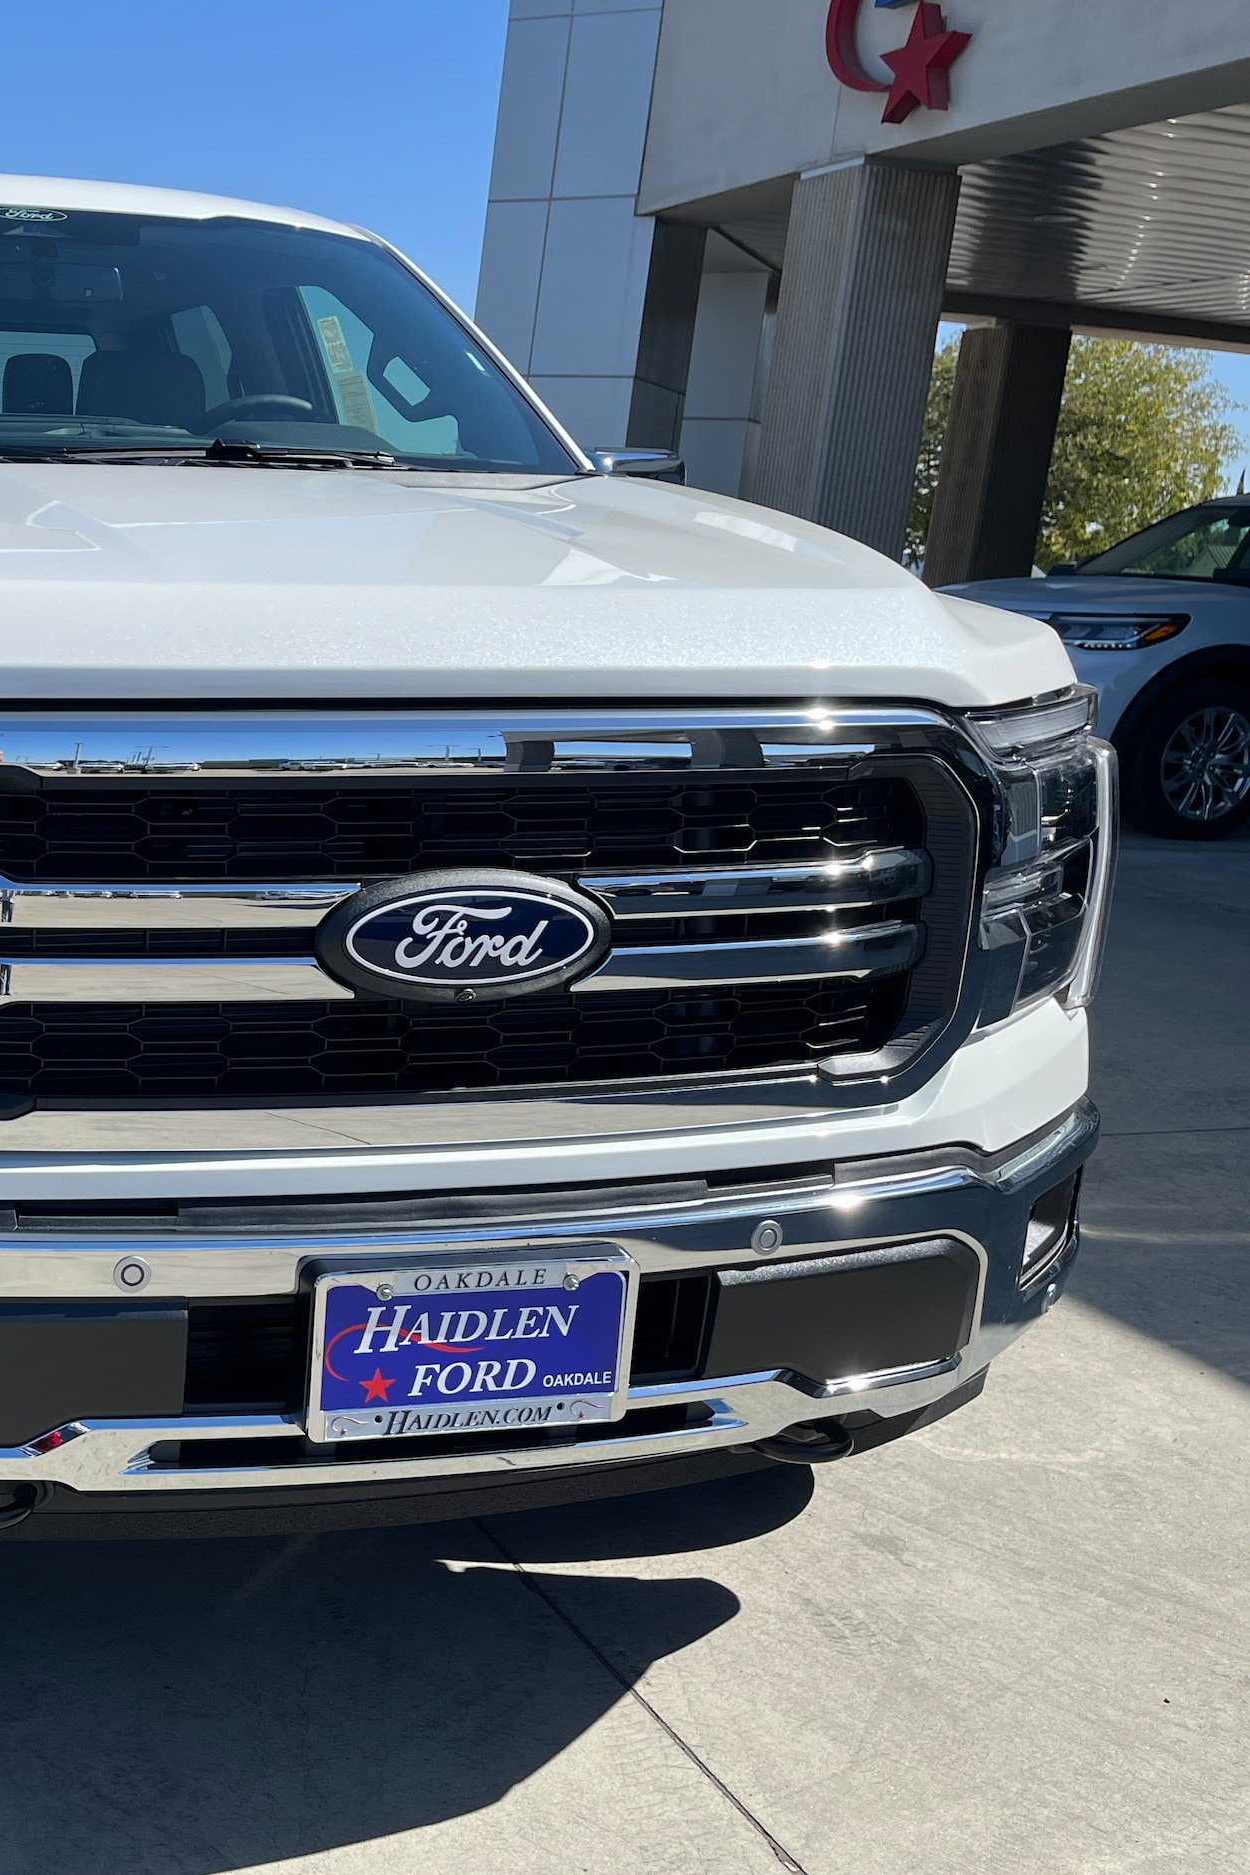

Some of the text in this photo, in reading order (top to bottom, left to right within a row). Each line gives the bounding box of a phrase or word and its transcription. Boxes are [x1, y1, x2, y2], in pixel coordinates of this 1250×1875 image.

[395, 904, 549, 968] Ford
[413, 1268, 547, 1291] OAKDALE
[353, 1304, 580, 1354] HAIDLEN
[406, 1358, 537, 1397] FORD
[542, 1370, 612, 1388] OAKDALE
[383, 1406, 553, 1435] HAIDLEN.COM
